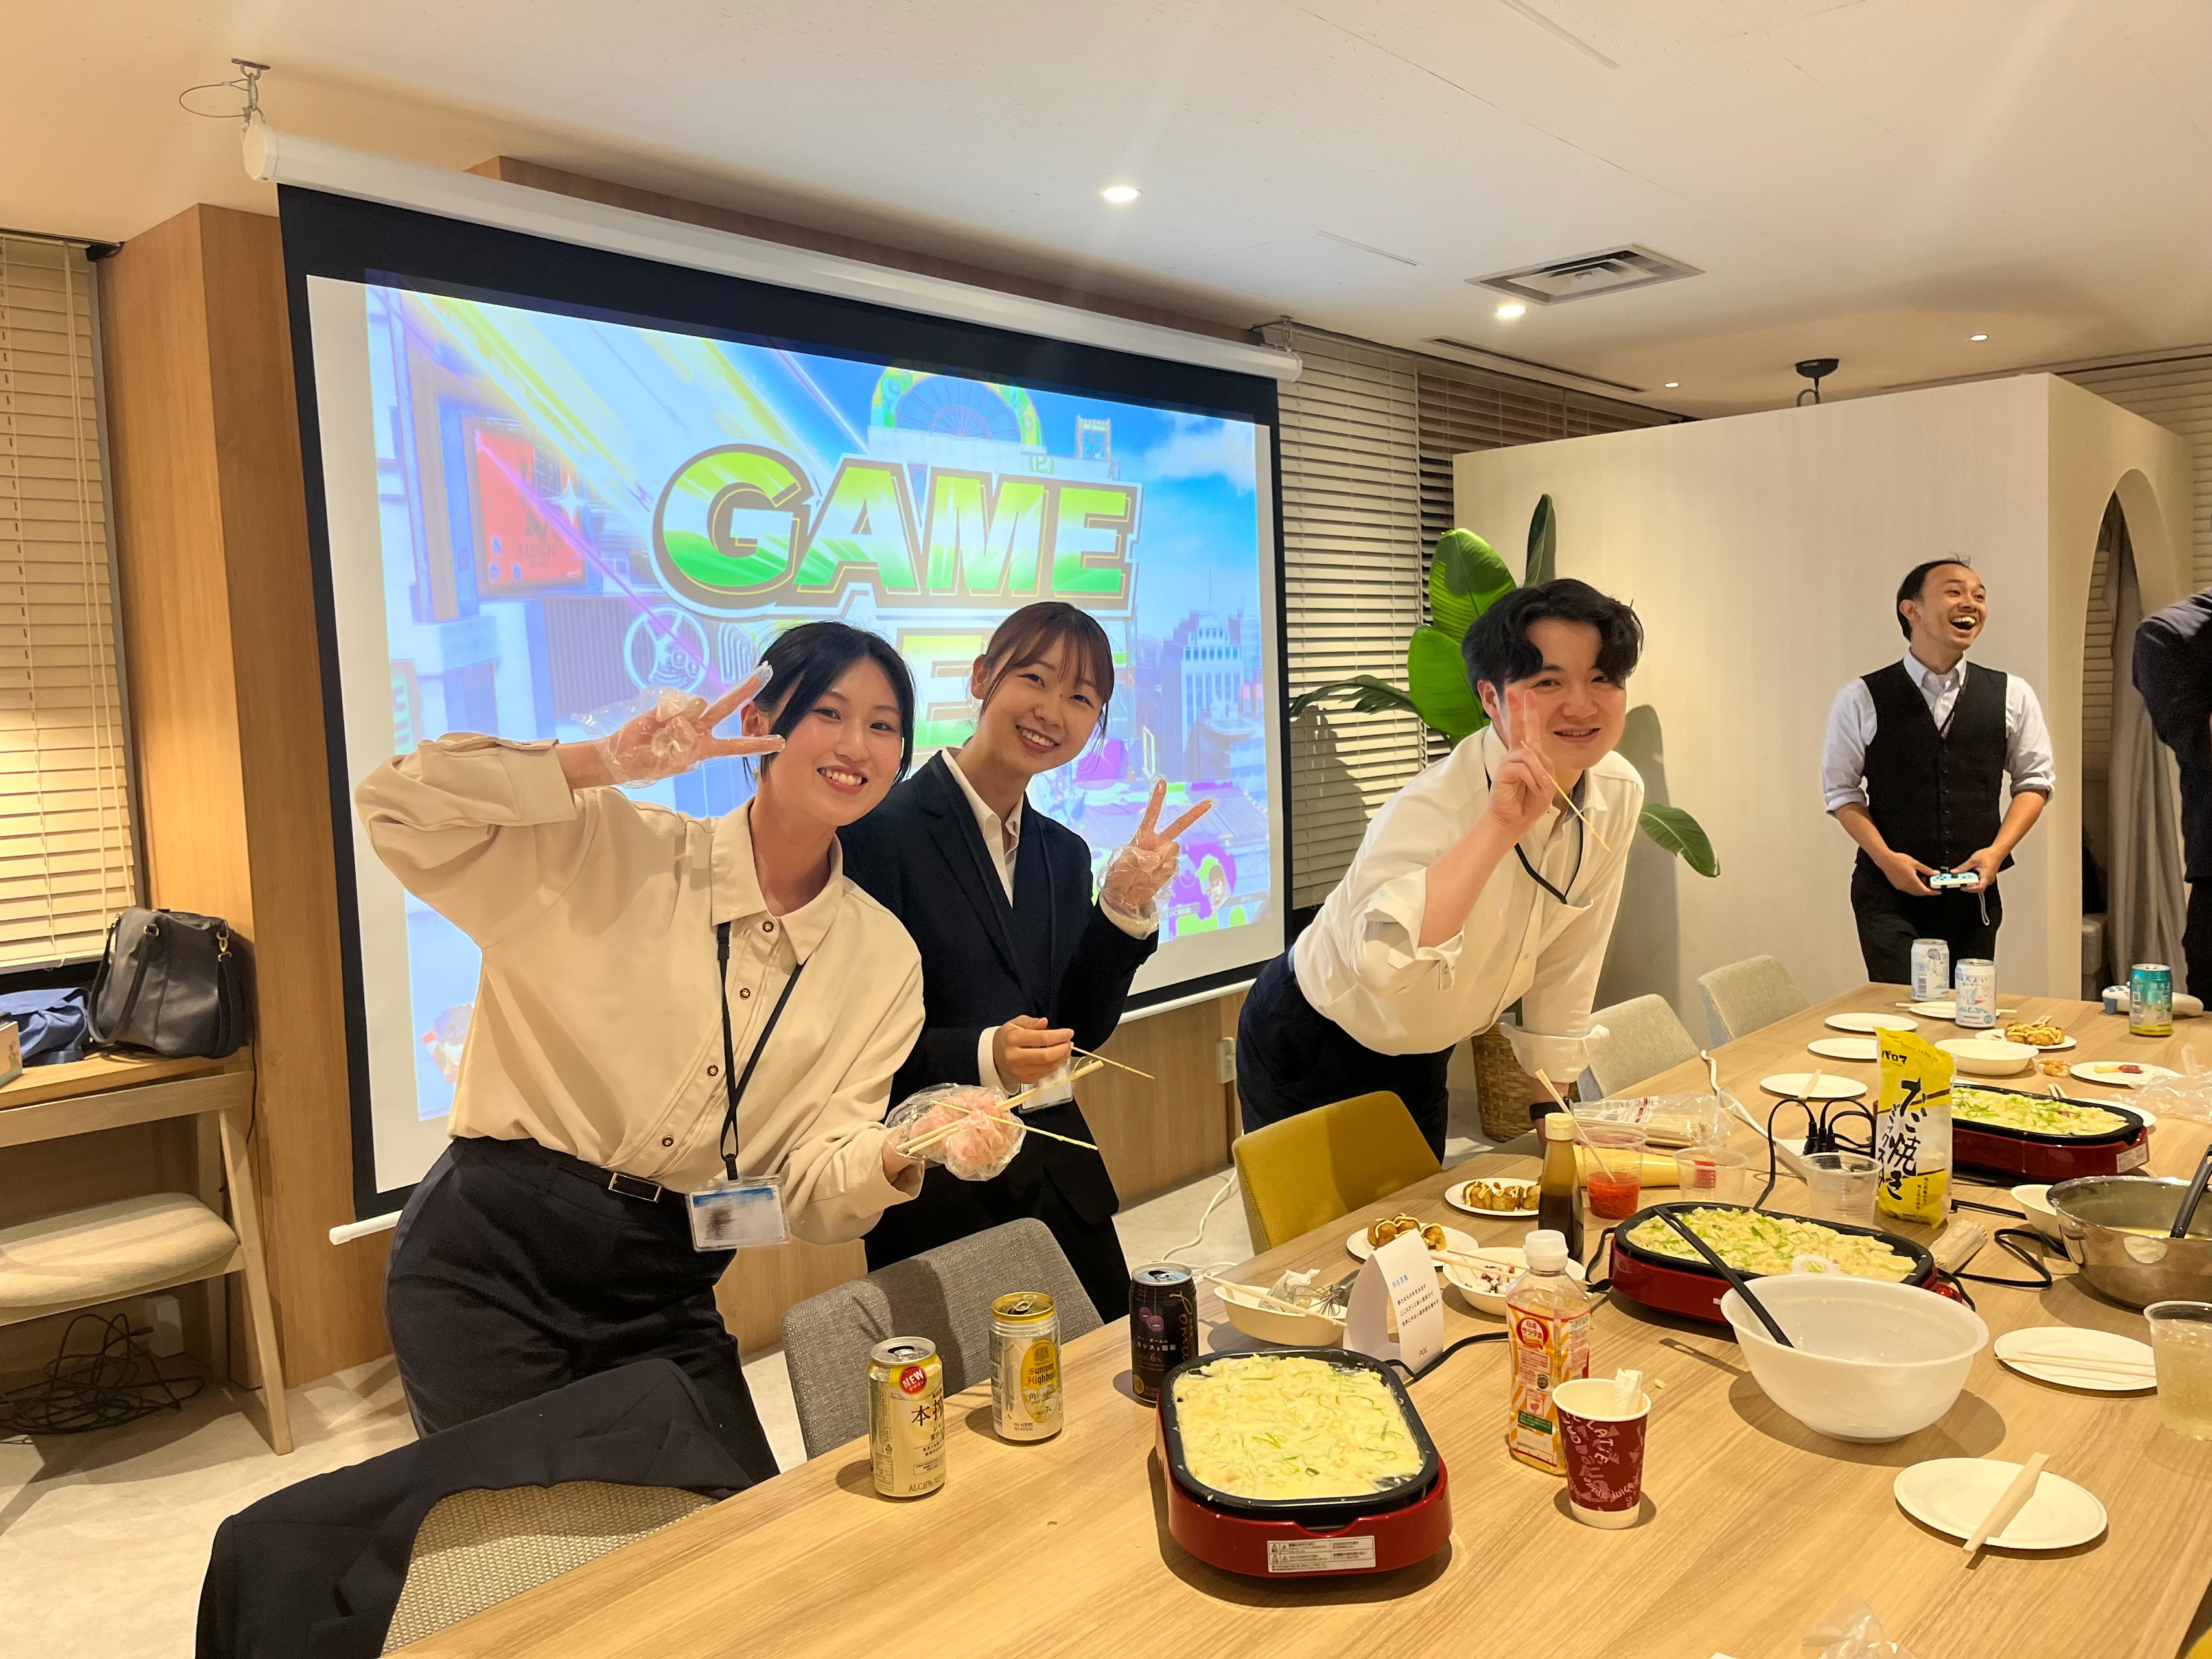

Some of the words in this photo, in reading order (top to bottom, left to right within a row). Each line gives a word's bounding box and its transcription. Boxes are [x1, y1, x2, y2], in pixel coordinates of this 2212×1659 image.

[661, 450, 1128, 597] GAME
[1166, 907, 1191, 918] LUCARIO
[1881, 1050, 1907, 1065] パロマ
[1526, 1320, 1537, 1329] 日清
[1522, 1327, 1543, 1340] サラダ油
[902, 1369, 924, 1389] NEW
